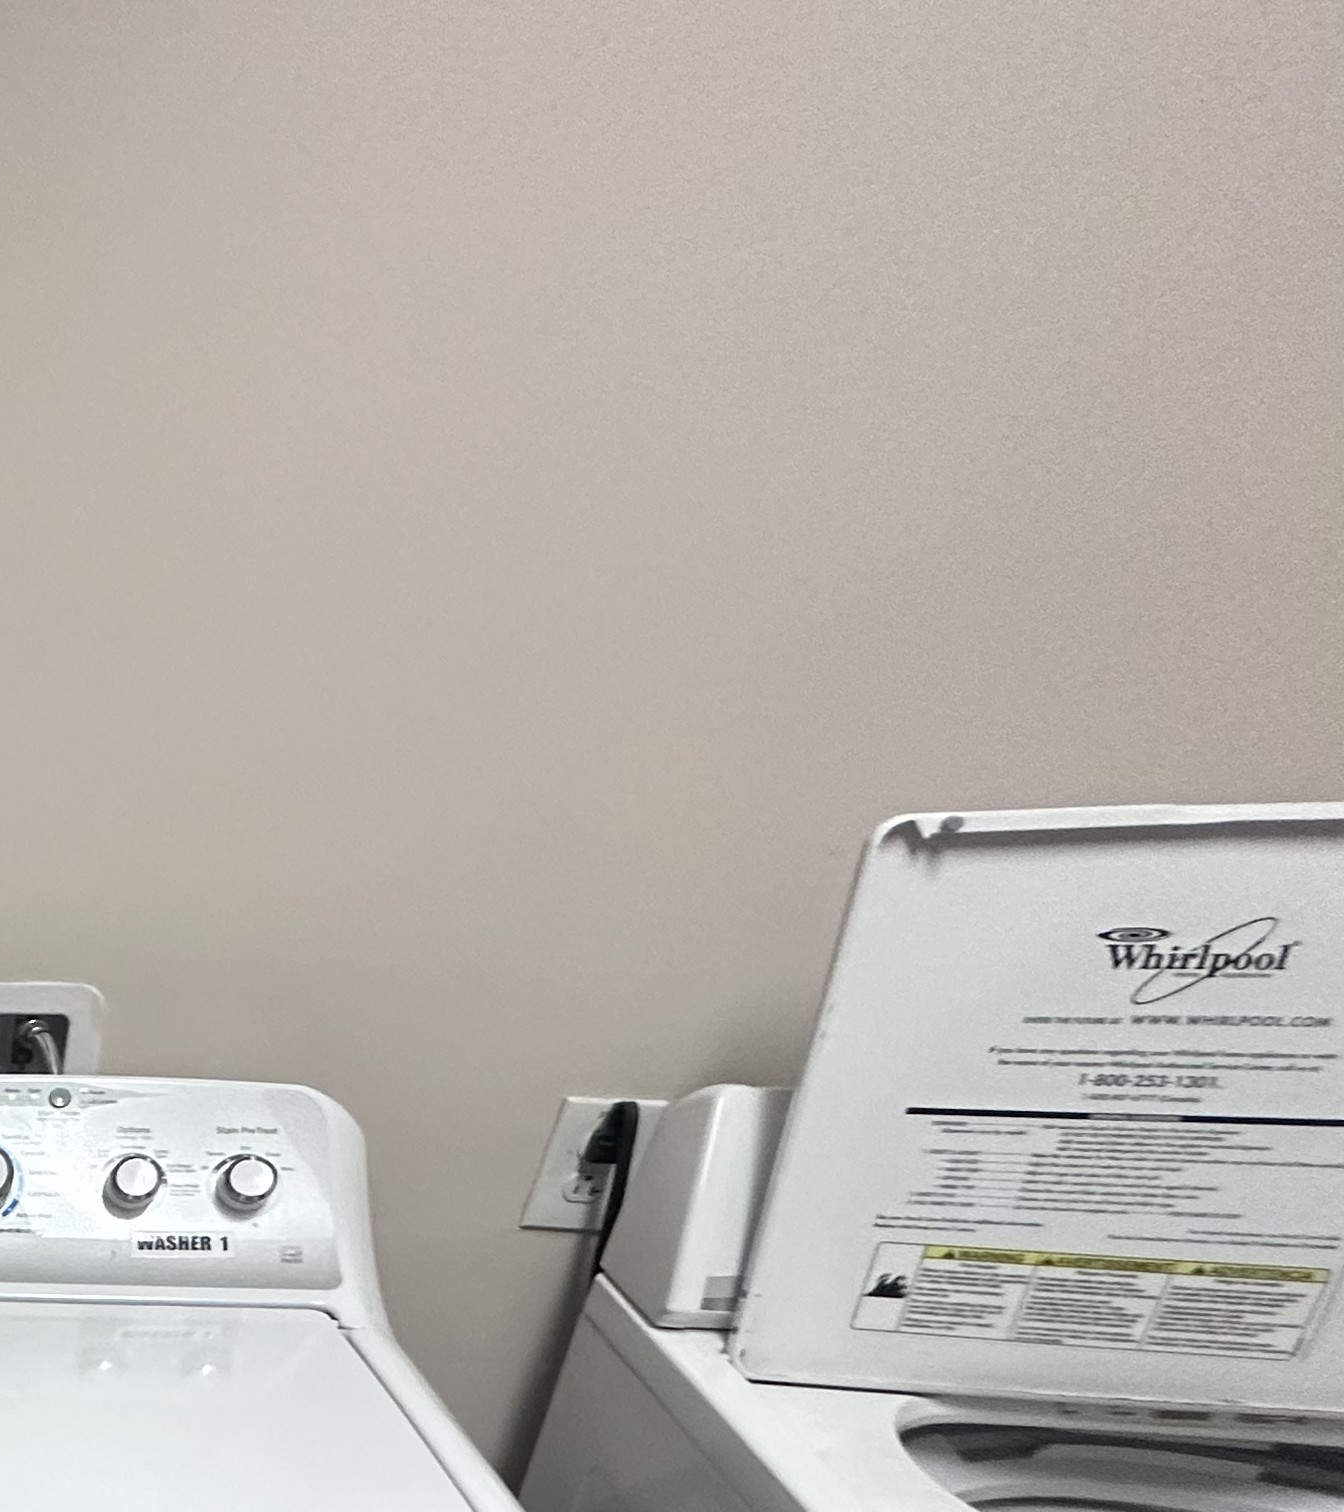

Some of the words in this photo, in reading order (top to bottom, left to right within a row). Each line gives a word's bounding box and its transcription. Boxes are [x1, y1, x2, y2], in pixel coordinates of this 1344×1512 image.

[1105, 944, 1295, 978] Whirlpool
[137, 1235, 211, 1251] WASHER
[221, 1236, 228, 1251] 1
